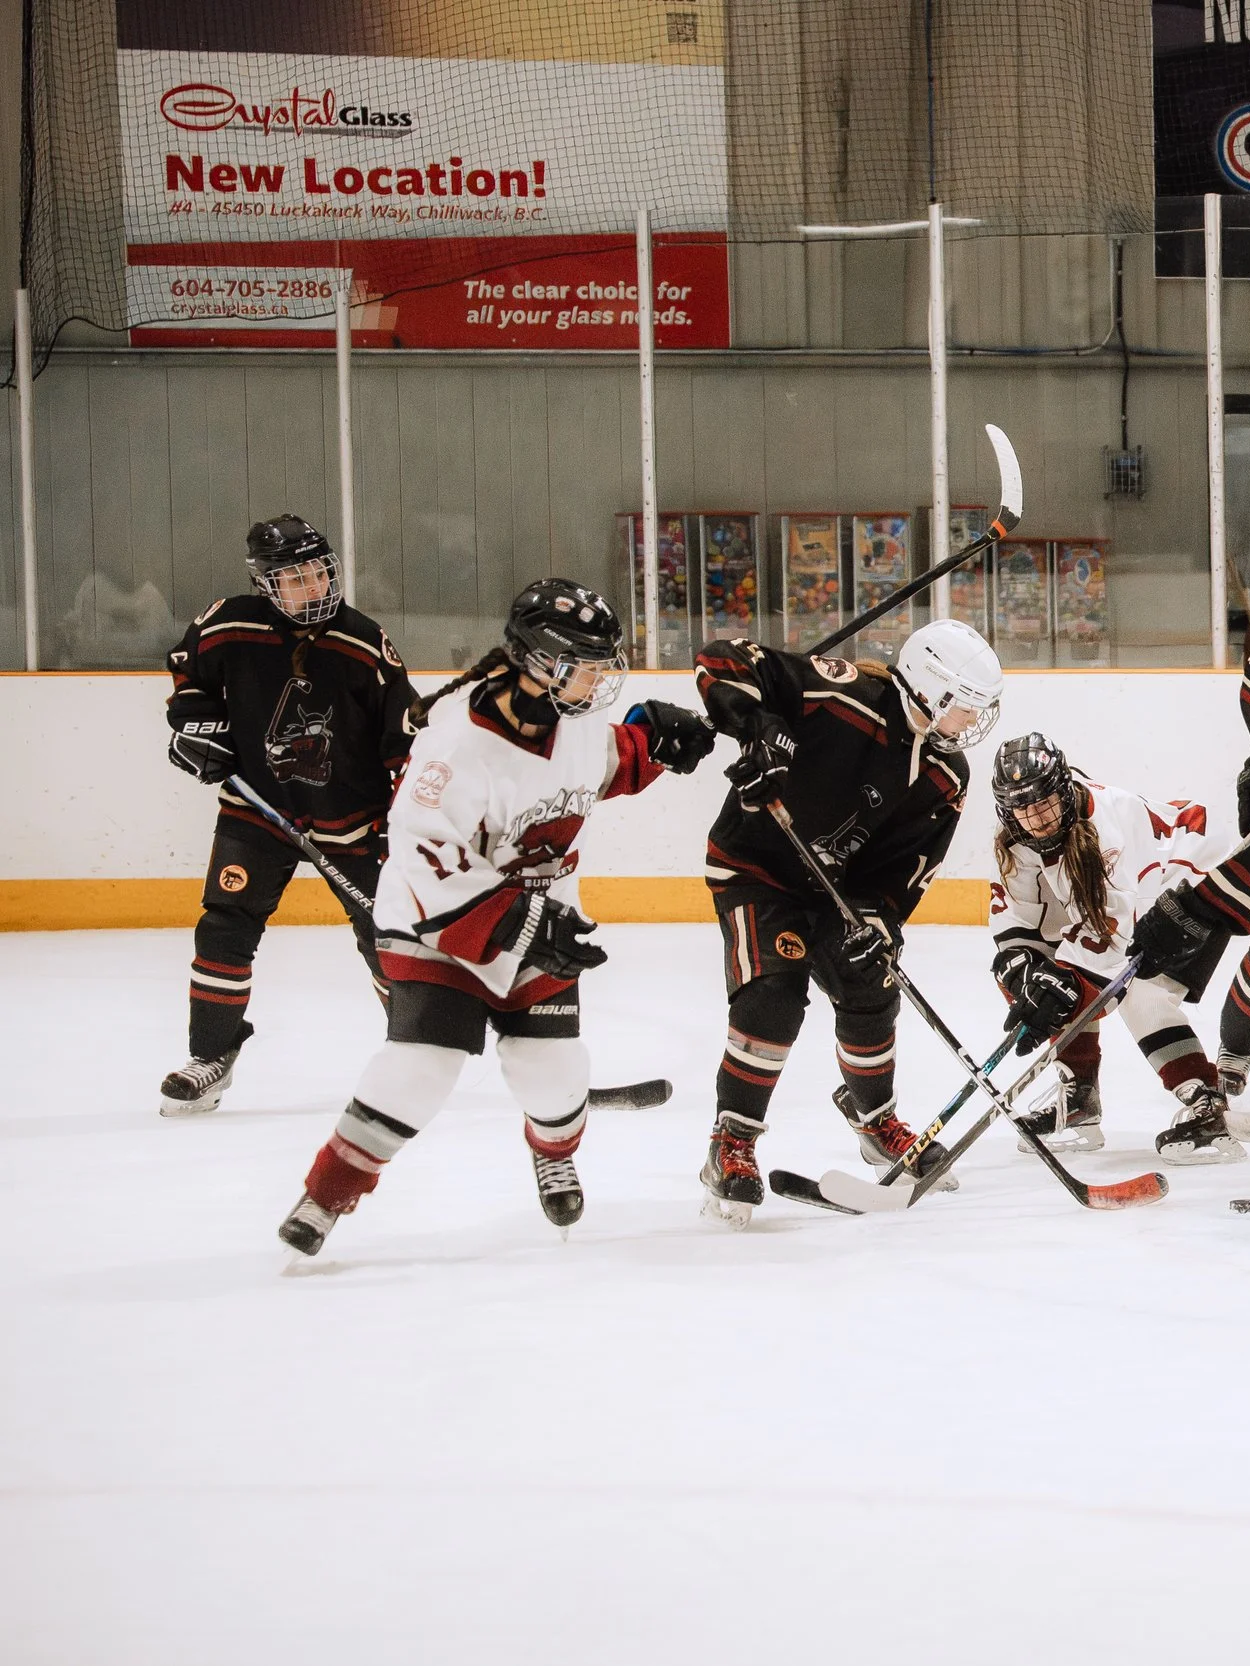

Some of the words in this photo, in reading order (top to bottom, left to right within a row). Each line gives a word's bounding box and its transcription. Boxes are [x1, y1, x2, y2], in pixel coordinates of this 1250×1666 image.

[160, 83, 339, 136] Crystal
[338, 106, 413, 127] Glass
[166, 154, 285, 194] New
[303, 155, 546, 198] Location!
[169, 202, 193, 216] #4
[211, 202, 264, 217] 45450
[270, 203, 362, 218] Luckakuck
[371, 205, 411, 223] Way,
[416, 205, 508, 222] Chilliwack,
[514, 207, 547, 221] B.C.
[171, 279, 333, 299] 604-705-2886
[463, 279, 506, 299] The
[511, 280, 571, 300] clear
[576, 280, 640, 300] choic
[656, 281, 693, 301] for
[171, 301, 289, 318] crystalglass.ca
[466, 305, 495, 324] all
[497, 310, 552, 329] your
[555, 305, 614, 330] glass
[182, 721, 231, 734] BAU
[325, 865, 374, 909] BAUER
[1032, 971, 1079, 1002] TRUE
[902, 1116, 945, 1168] CCM
